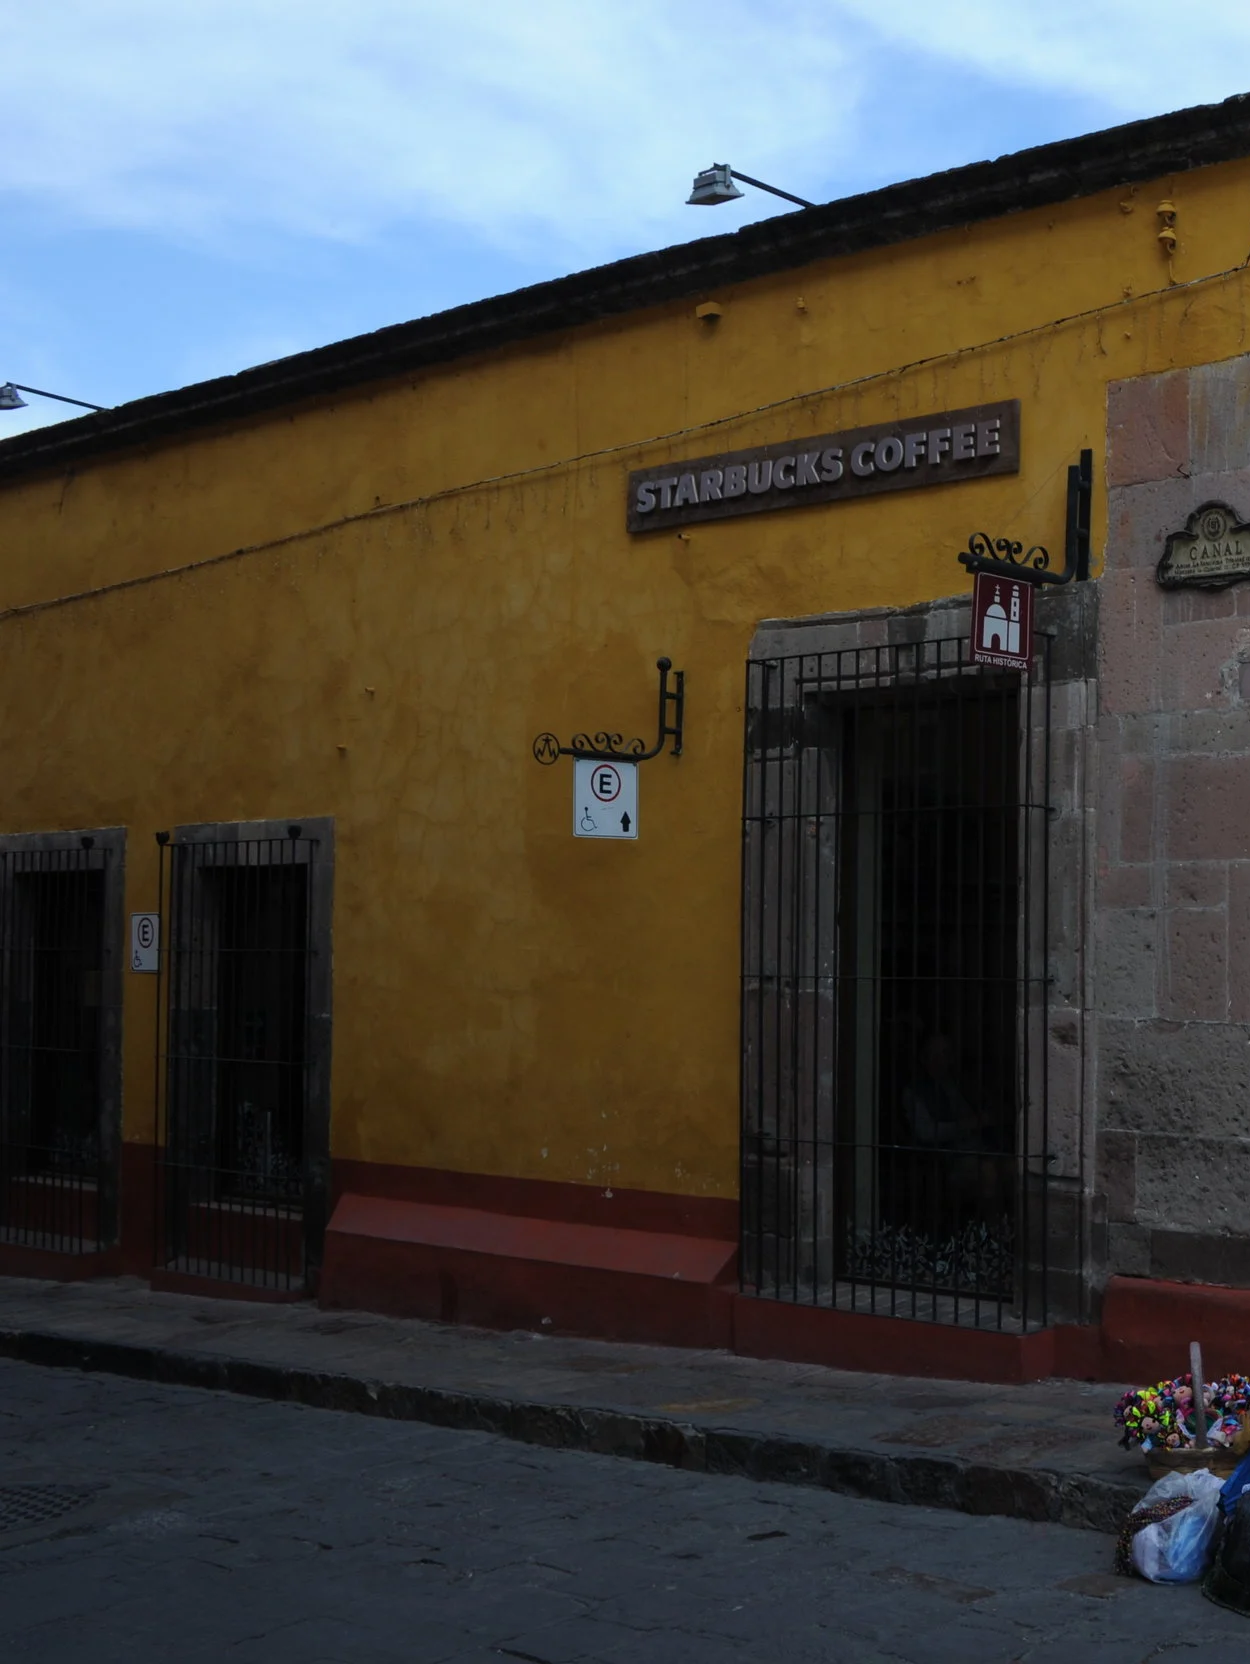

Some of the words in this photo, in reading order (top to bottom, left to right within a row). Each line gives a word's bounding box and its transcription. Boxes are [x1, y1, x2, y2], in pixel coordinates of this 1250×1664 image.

[636, 448, 844, 514] STARBUCKS
[850, 418, 1001, 477] COFFEE
[1189, 540, 1242, 561] CANAL
[974, 653, 992, 664] RUTA
[992, 656, 1028, 670] HISTÓRICA
[599, 773, 613, 795] E
[142, 924, 150, 942] E
